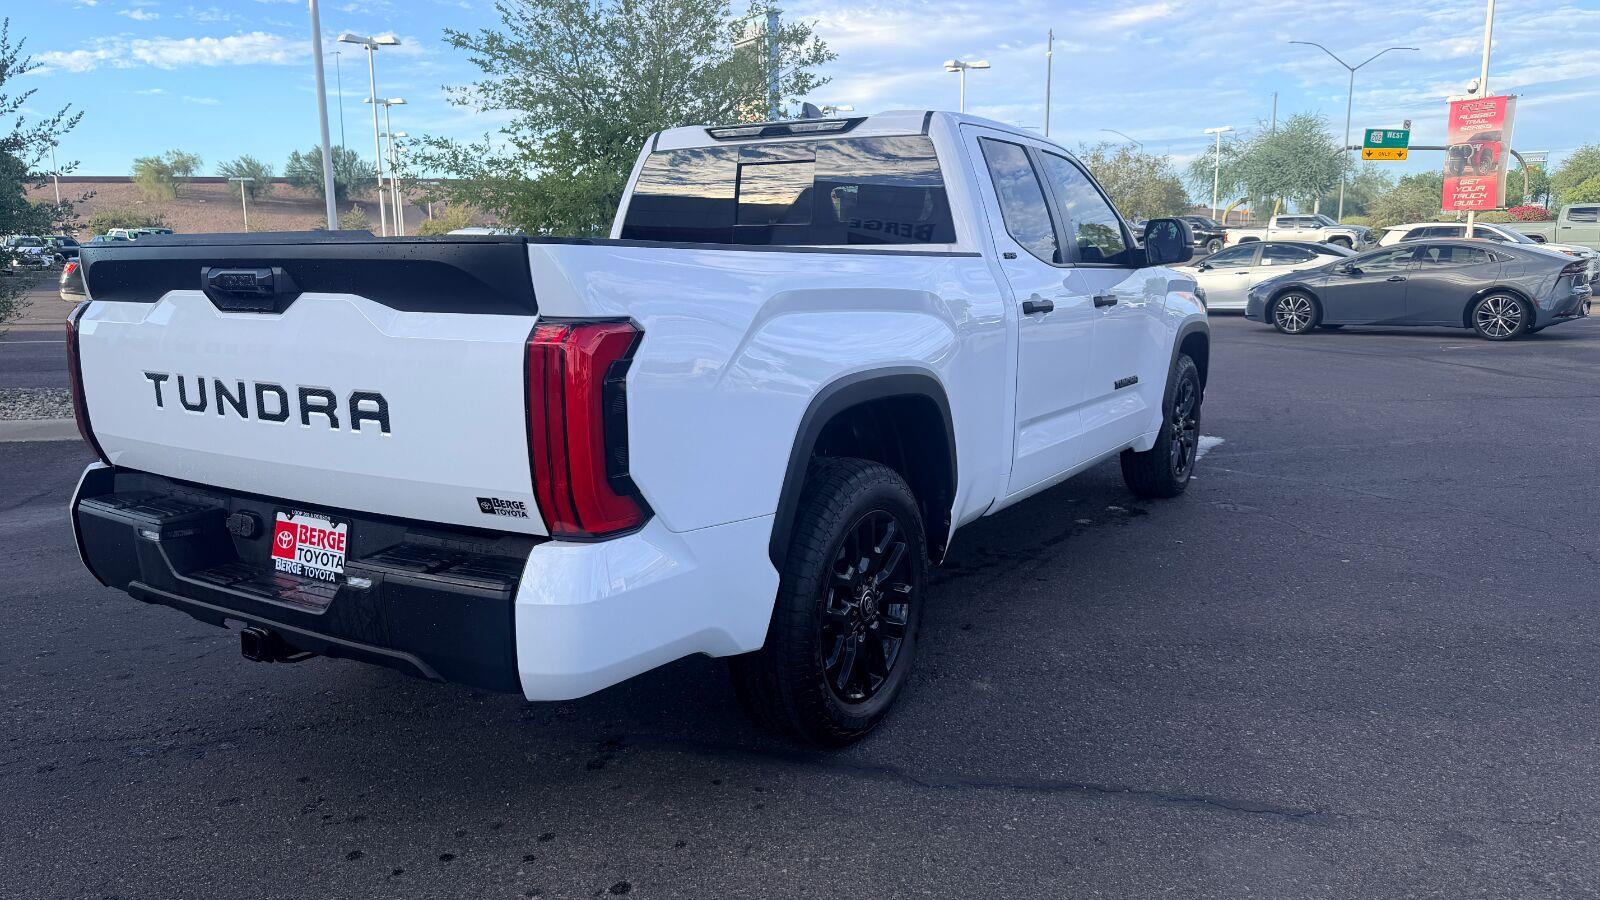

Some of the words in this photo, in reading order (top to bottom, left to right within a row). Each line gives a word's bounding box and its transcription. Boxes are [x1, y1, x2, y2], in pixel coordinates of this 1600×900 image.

[1458, 112, 1497, 120] RUGGED
[1386, 131, 1404, 139] WEST
[143, 371, 391, 434] TUNDRA
[491, 497, 526, 511] BERGE
[495, 508, 529, 518] TOYOTA
[299, 524, 345, 551] BERGE
[297, 548, 344, 570] TOYOTA
[275, 559, 302, 574] BERGE
[303, 566, 336, 582] TOYOTA
